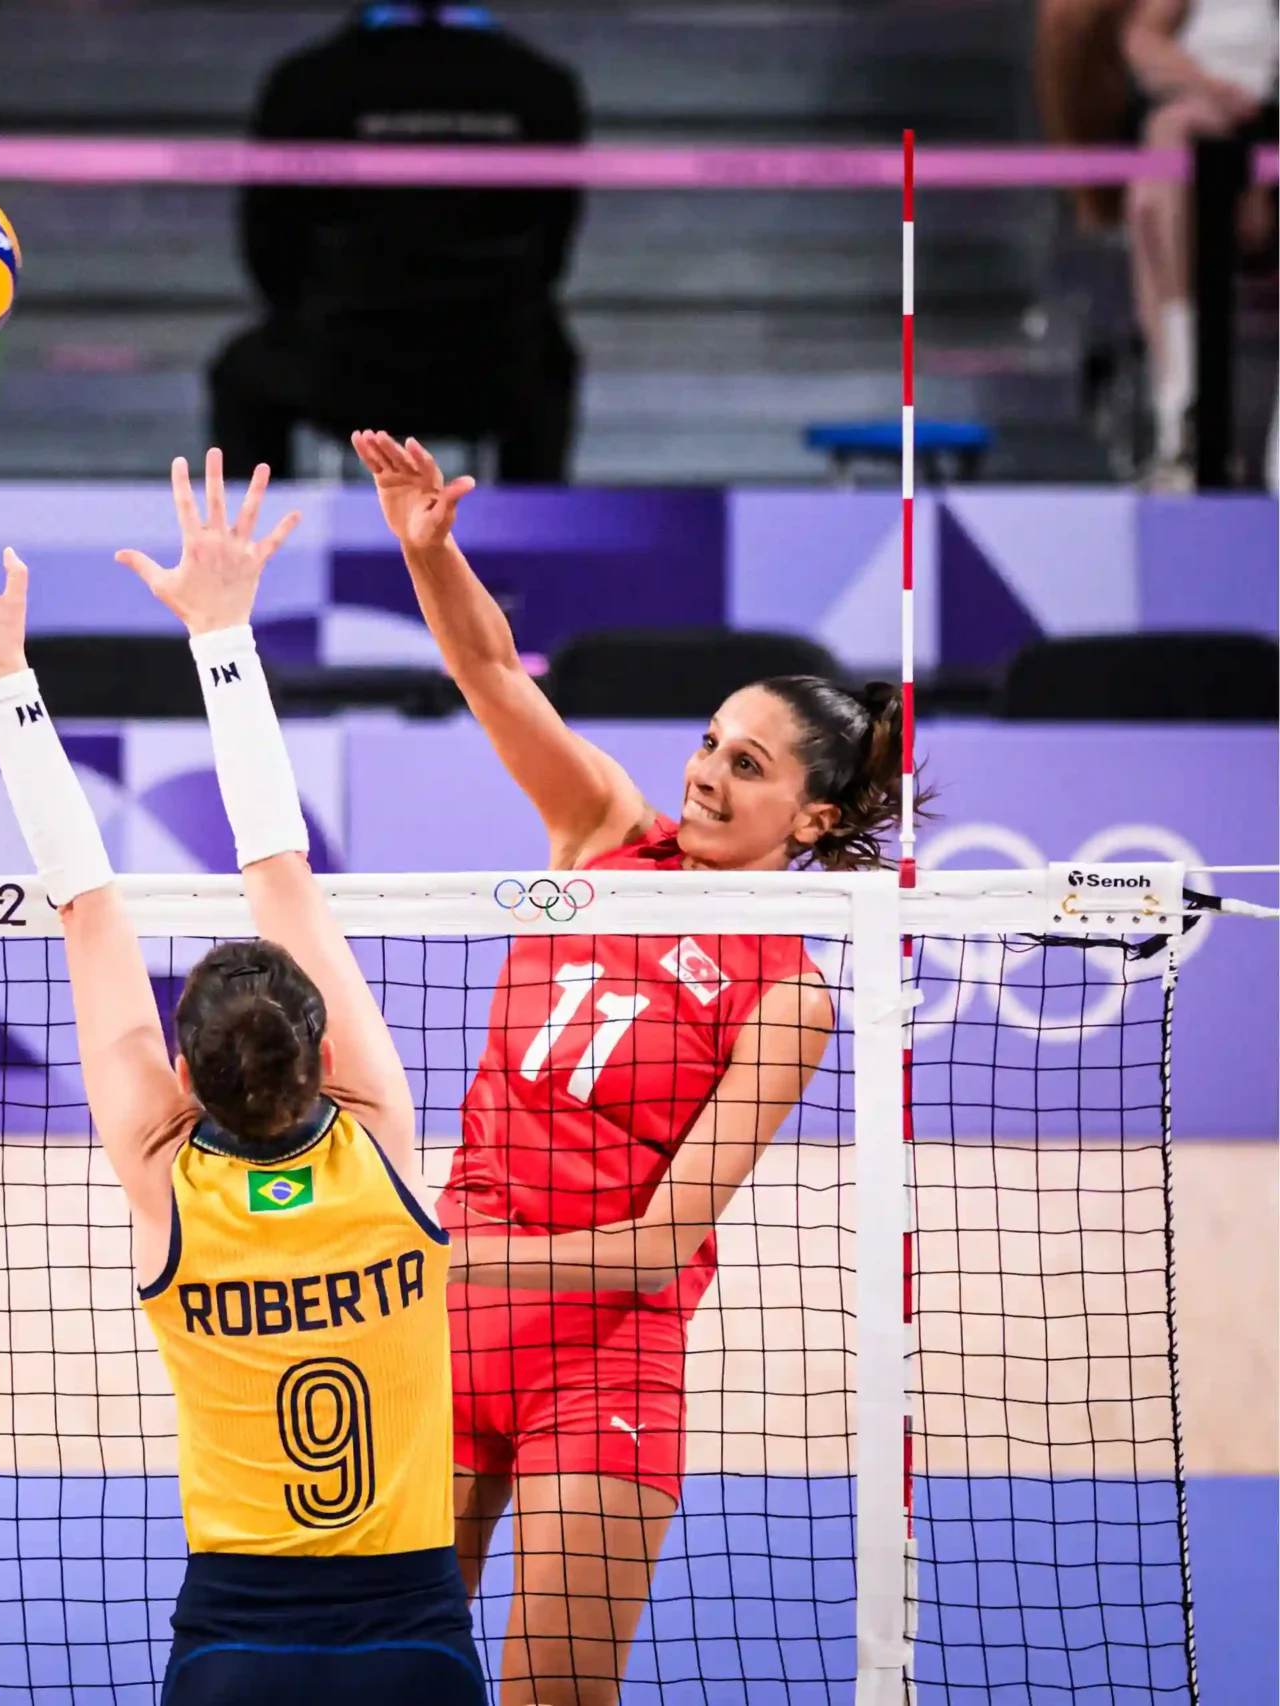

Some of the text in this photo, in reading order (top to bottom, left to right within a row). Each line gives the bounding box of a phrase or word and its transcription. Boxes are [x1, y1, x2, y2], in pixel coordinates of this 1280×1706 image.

[1086, 873, 1151, 888] Senoh
[520, 961, 651, 1104] 11
[178, 1249, 425, 1337] ROBERTA
[276, 1356, 376, 1530] 9
